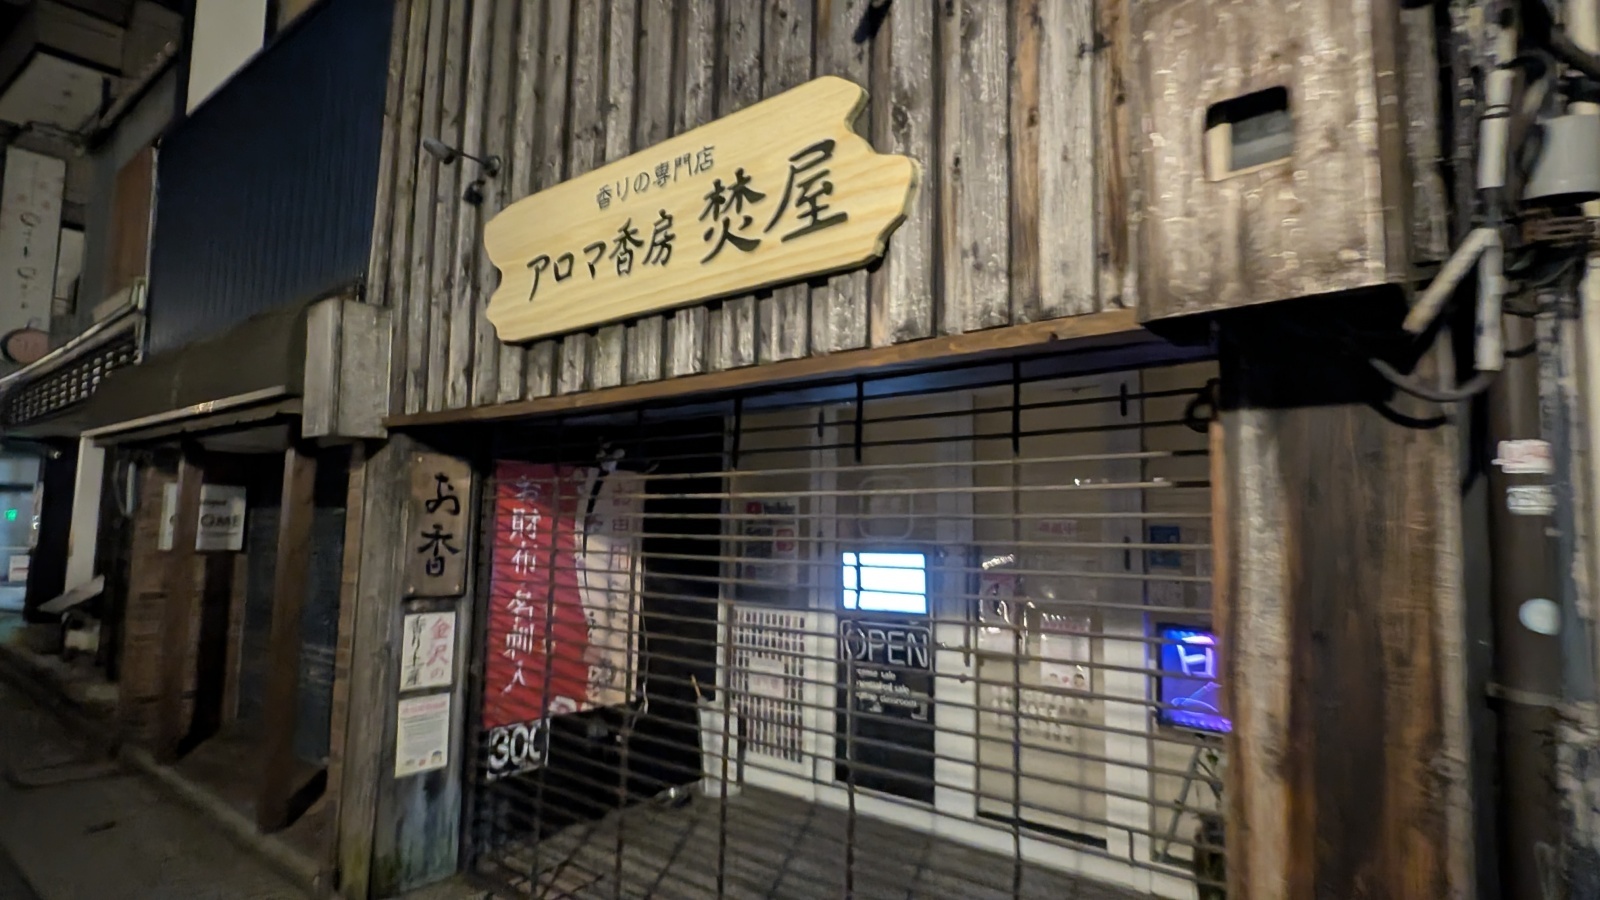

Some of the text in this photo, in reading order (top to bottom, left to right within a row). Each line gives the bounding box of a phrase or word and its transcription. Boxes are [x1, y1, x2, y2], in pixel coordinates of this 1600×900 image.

[596, 146, 715, 208] 香りの専門店
[526, 139, 848, 302] アロマ香房 焚屋
[417, 472, 461, 578] お香
[845, 627, 929, 668] OPEN
